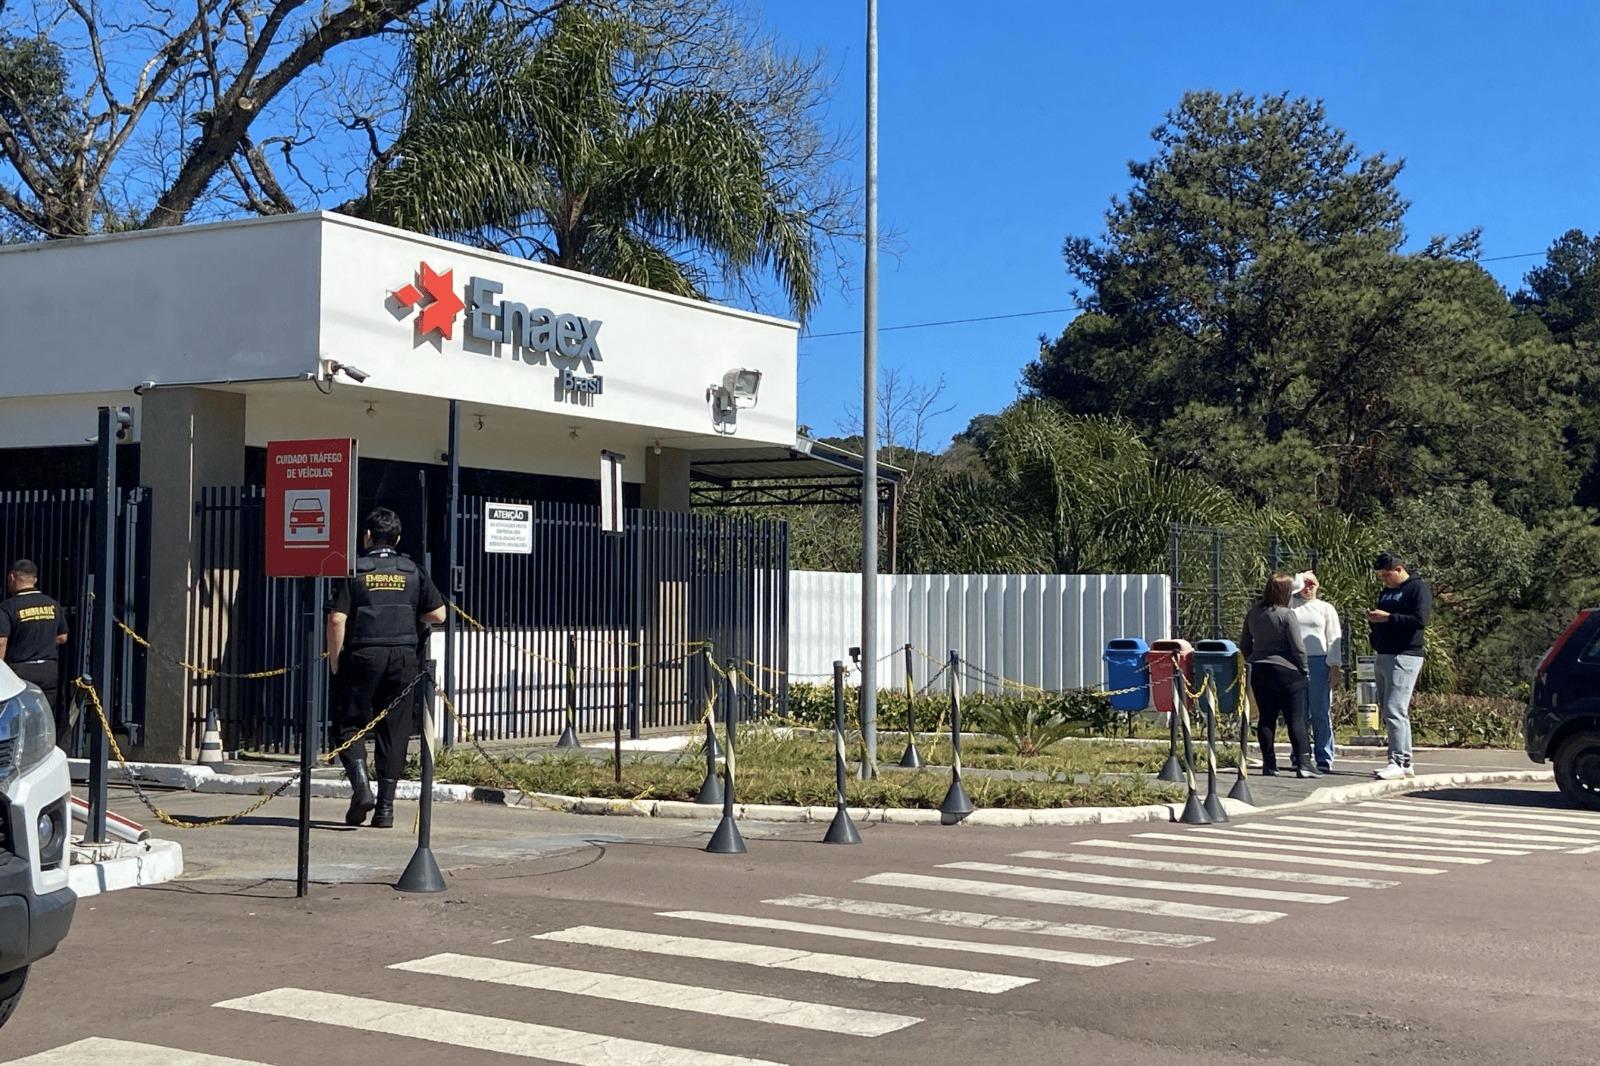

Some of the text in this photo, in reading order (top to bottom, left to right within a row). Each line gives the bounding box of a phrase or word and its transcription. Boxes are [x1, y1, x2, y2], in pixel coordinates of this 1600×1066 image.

[470, 276, 603, 361] Enaex
[560, 369, 603, 394] Brasil
[275, 452, 343, 465] CUIDADO TRÁFEGO
[286, 466, 333, 478] DE VEÍCULOS
[493, 510, 524, 520] ATENÇÃO
[365, 574, 406, 583] EMBRASIL
